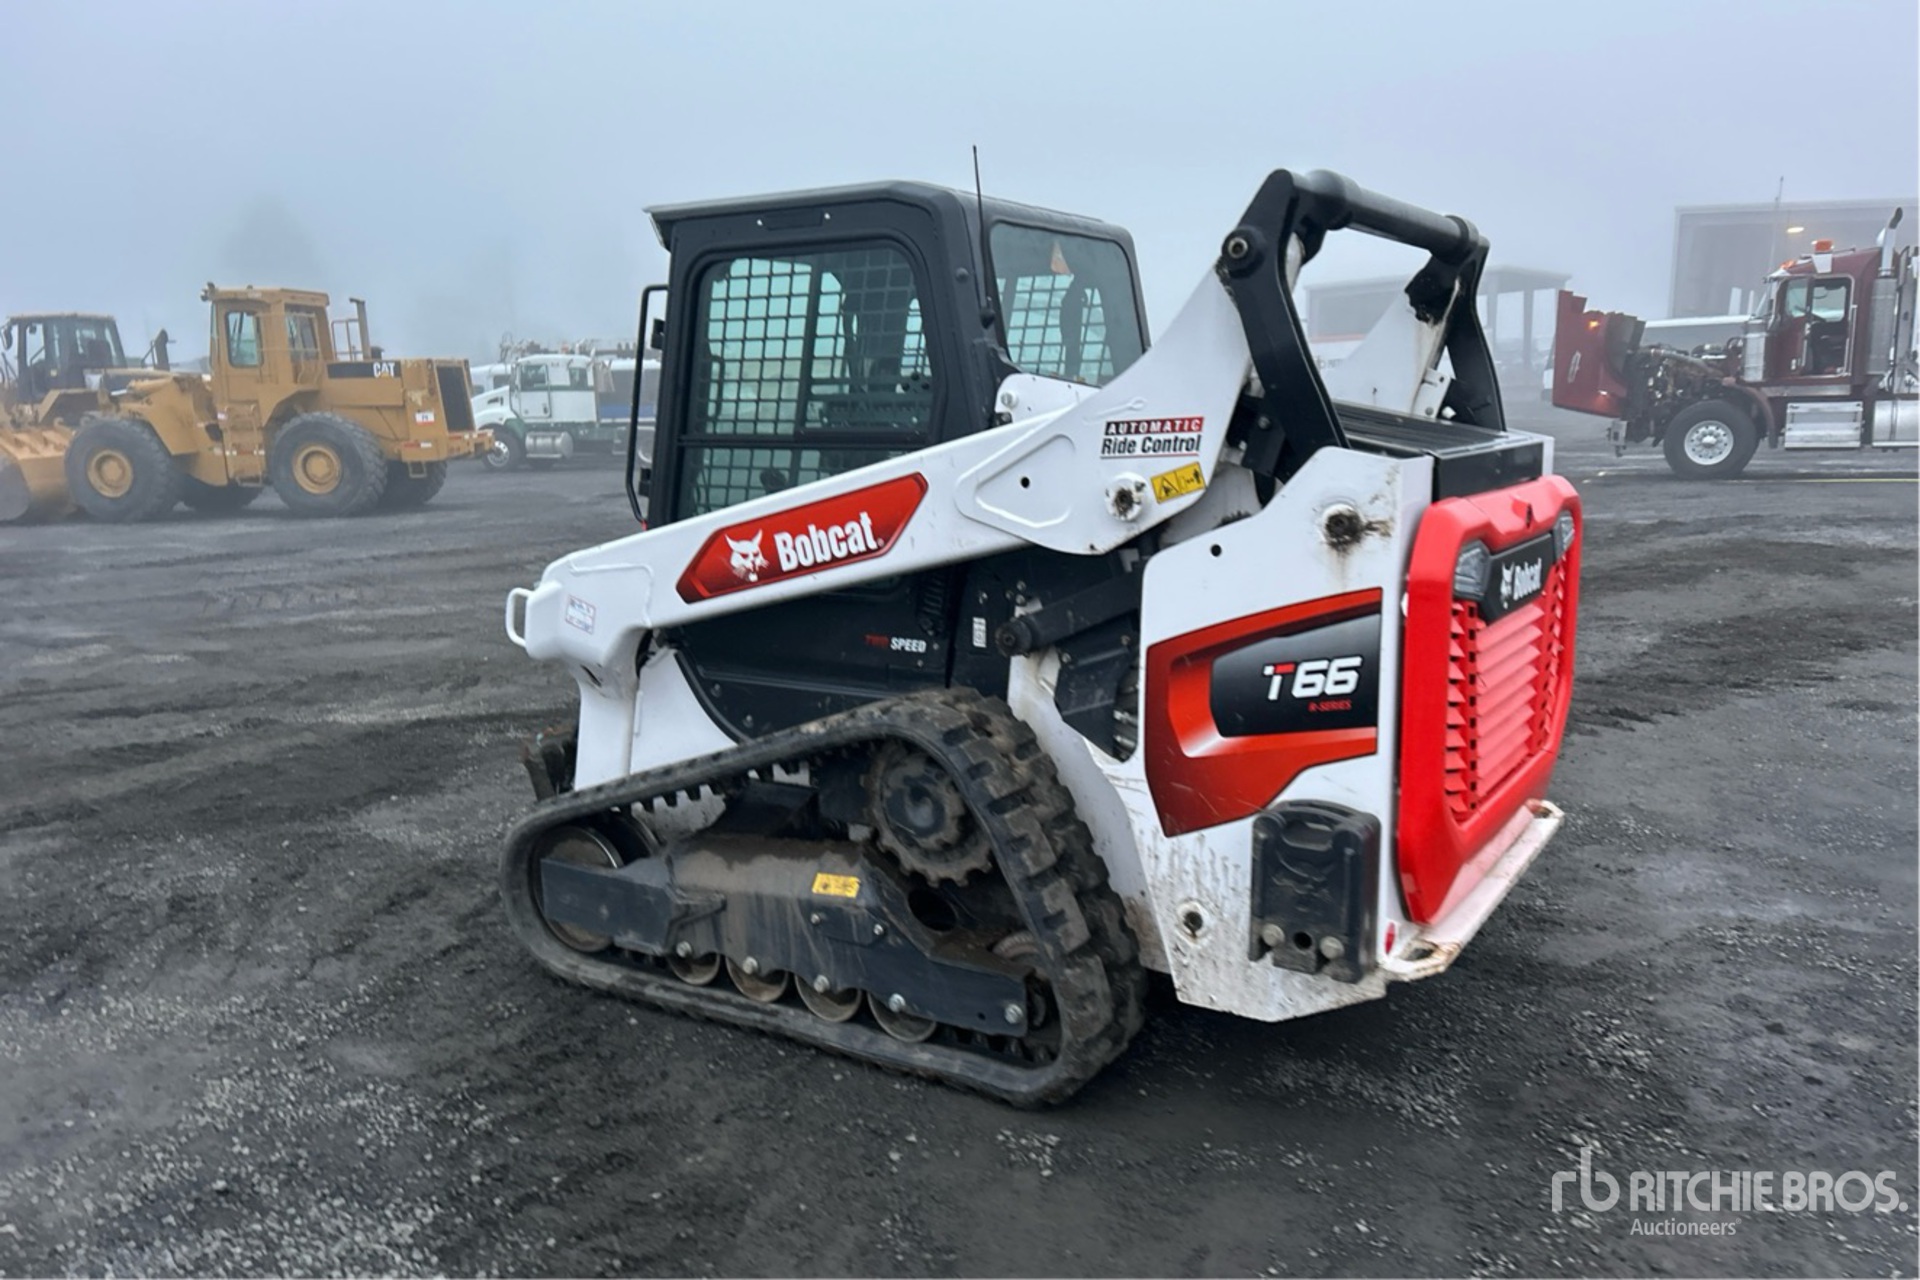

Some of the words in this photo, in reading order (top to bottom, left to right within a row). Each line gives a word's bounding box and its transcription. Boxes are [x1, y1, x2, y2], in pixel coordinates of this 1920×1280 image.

[373, 362, 396, 378] CAT
[1107, 418, 1202, 435] AUTOMATIC
[1101, 437, 1137, 455] Ride
[1141, 434, 1202, 453] Control
[1513, 557, 1542, 601] Bobcat
[890, 636, 927, 653] SPEED
[1263, 656, 1362, 701] T66
